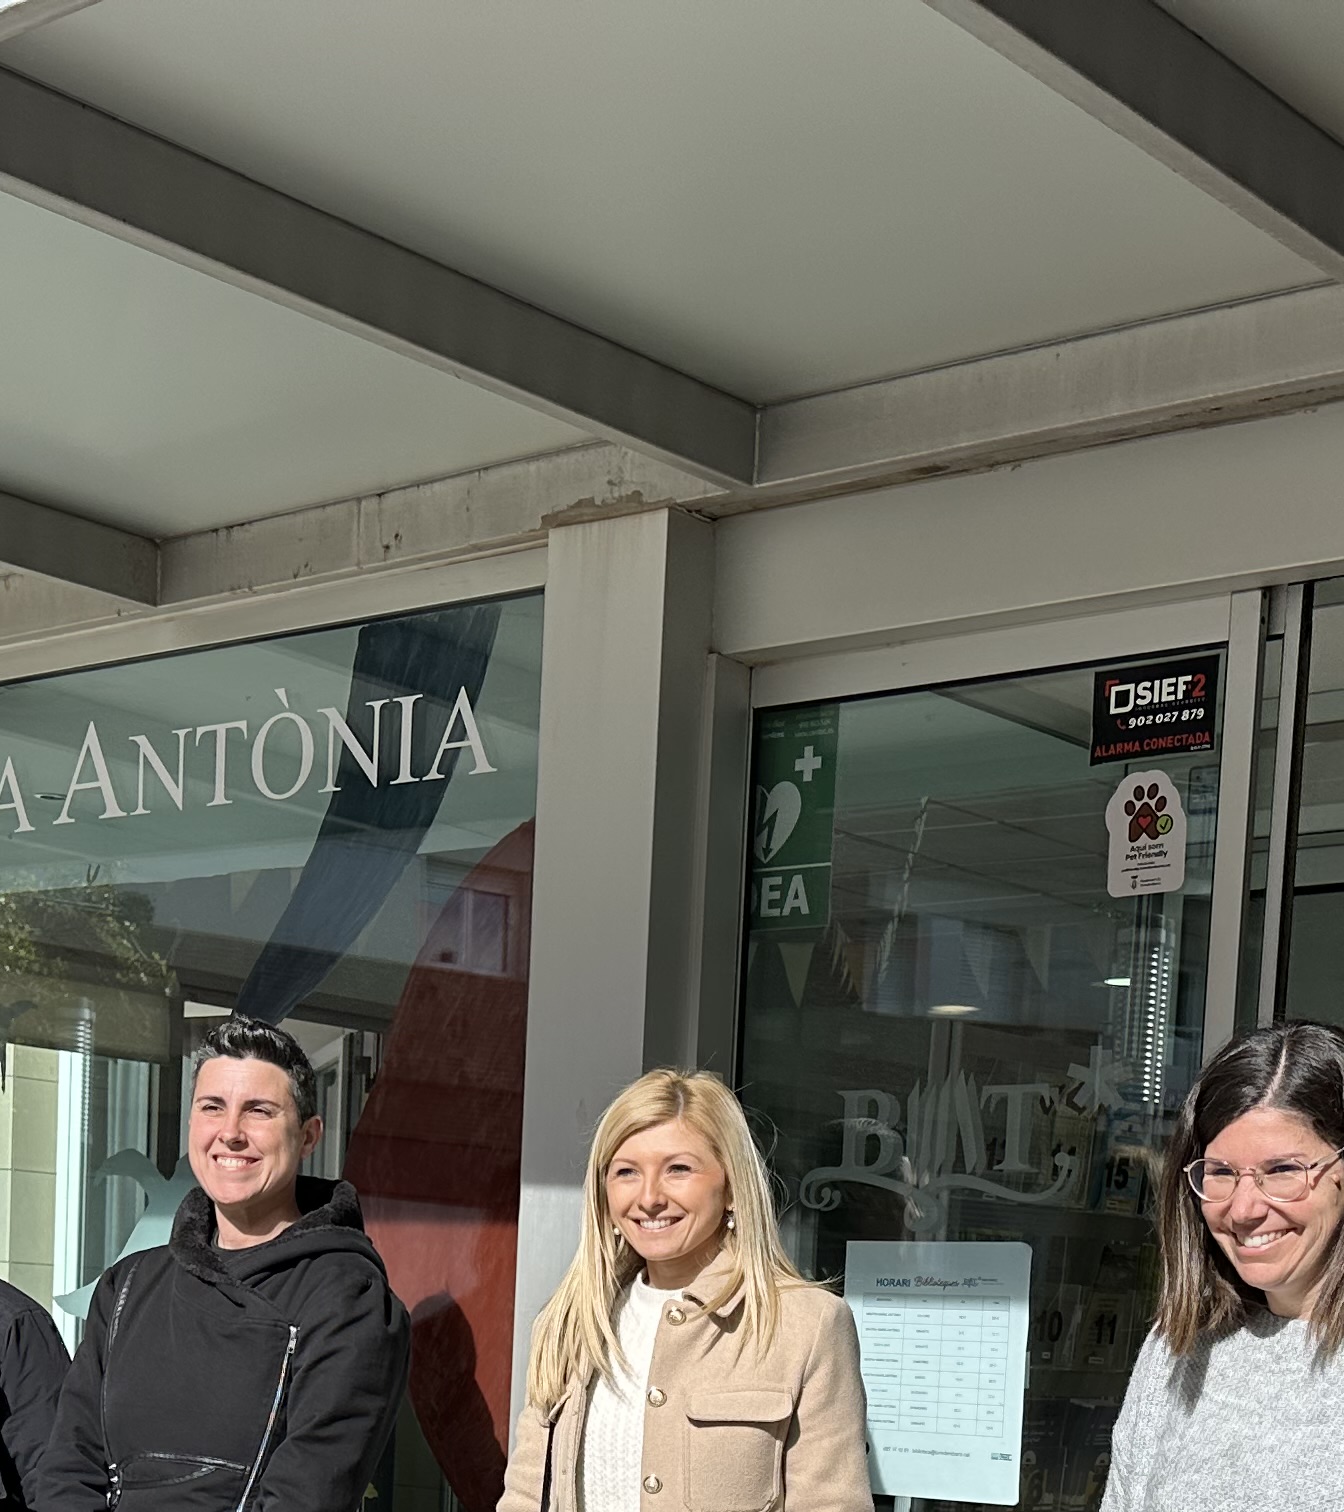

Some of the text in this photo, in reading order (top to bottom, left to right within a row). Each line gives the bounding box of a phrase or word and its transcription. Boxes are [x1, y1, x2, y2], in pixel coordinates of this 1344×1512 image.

[1128, 707, 1205, 729] 902 027 879
[53, 685, 498, 825] ANTÒNIA
[1094, 731, 1211, 758] ALARMA CONECTADA
[751, 874, 810, 918] EA
[876, 1277, 911, 1288] HORARI
